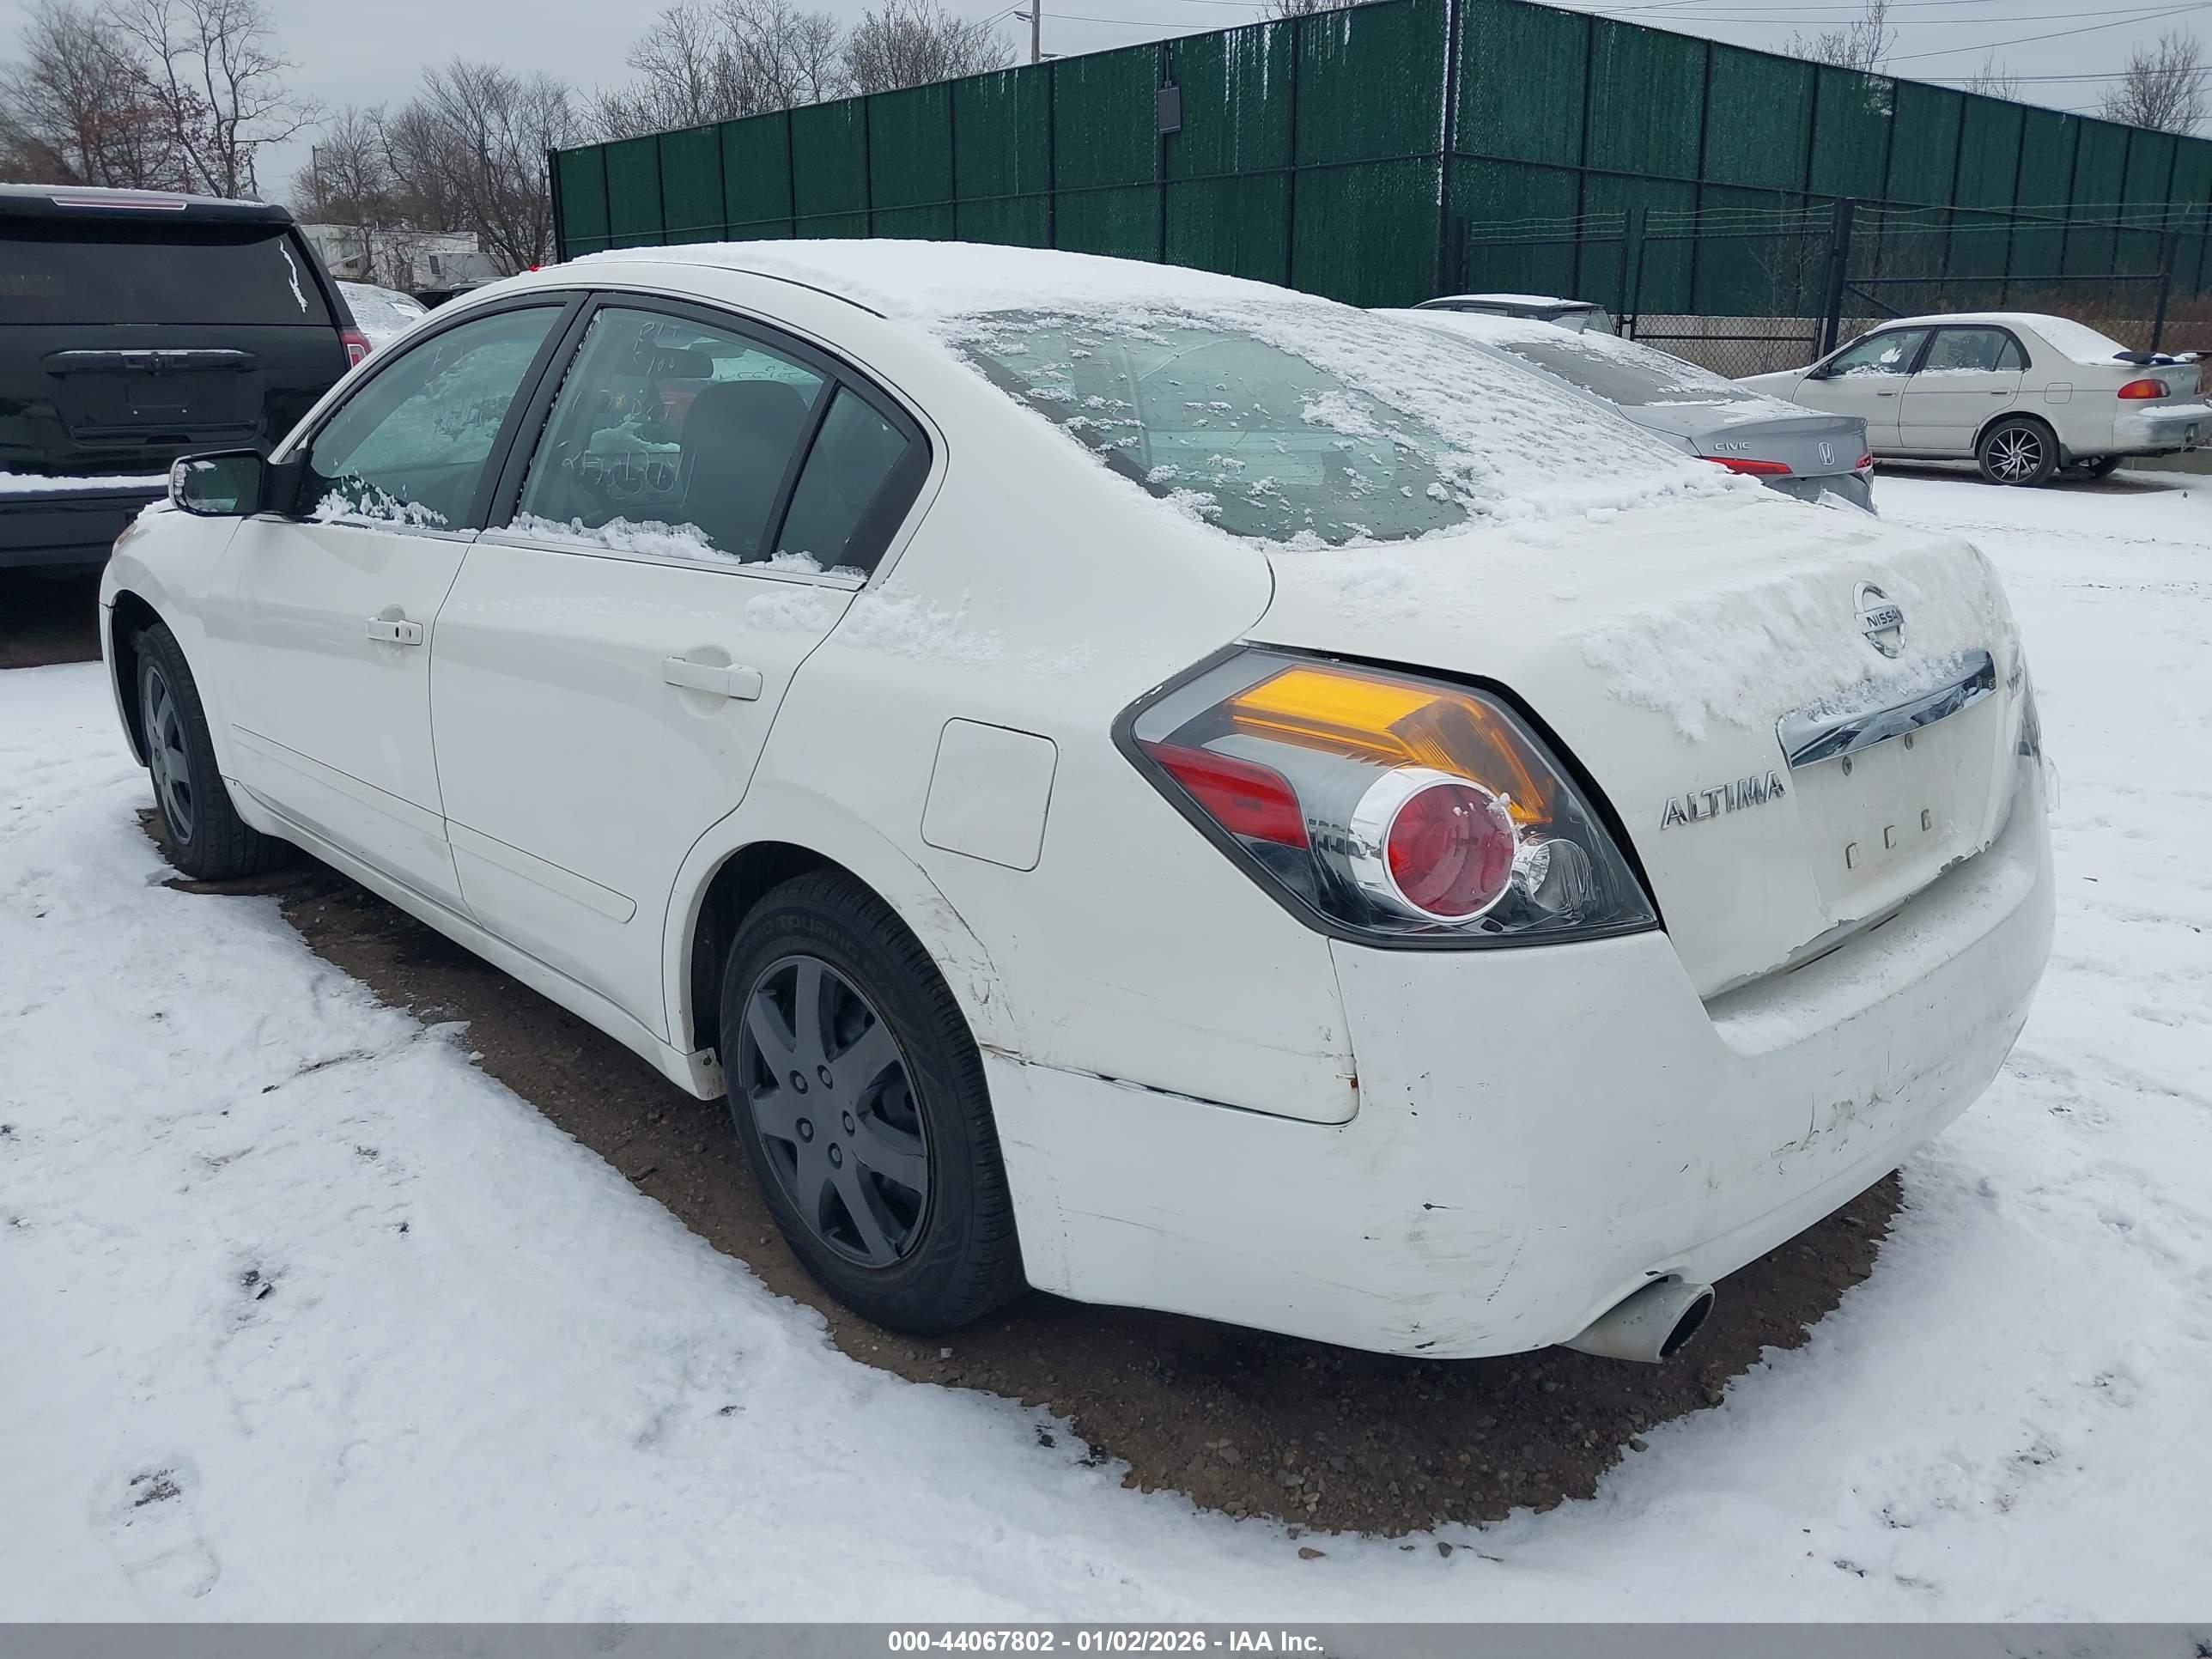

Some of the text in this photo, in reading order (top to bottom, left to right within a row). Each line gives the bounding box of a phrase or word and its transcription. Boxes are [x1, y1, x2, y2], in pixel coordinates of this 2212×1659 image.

[1713, 441, 1753, 452] CIVIC
[1865, 608, 1900, 628] NISSA
[1661, 770, 1786, 830] ALTIMA
[777, 915, 860, 962] TOURING
